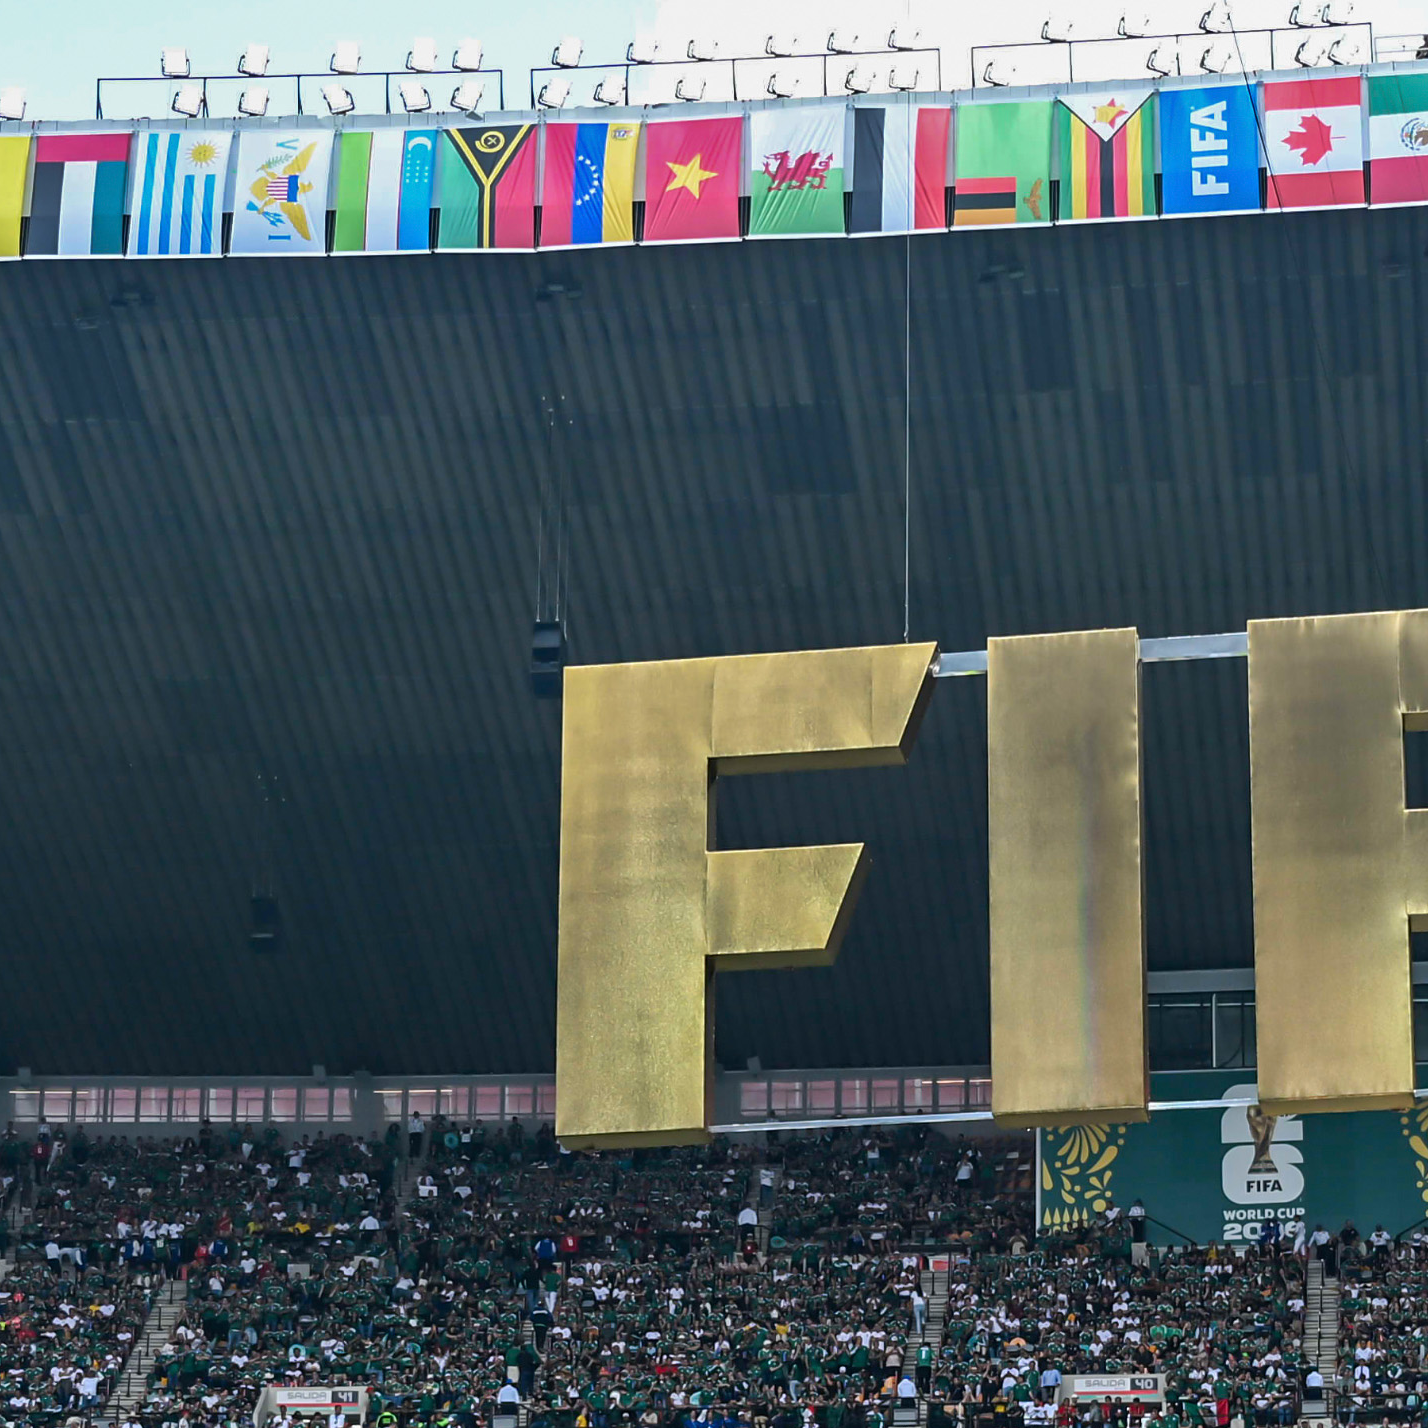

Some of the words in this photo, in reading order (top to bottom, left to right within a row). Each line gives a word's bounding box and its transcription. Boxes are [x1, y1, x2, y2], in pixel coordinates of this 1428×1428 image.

[1190, 100, 1229, 196] FIFA
[1246, 1179, 1283, 1193] FIFA
[1223, 1209, 1275, 1221] WORLD
[1277, 1207, 1305, 1219] CUP
[1223, 1221, 1299, 1241] 206
[1084, 1380, 1126, 1389] SALIDA
[1134, 1379, 1154, 1390] 40
[337, 1391, 353, 1402] 41
